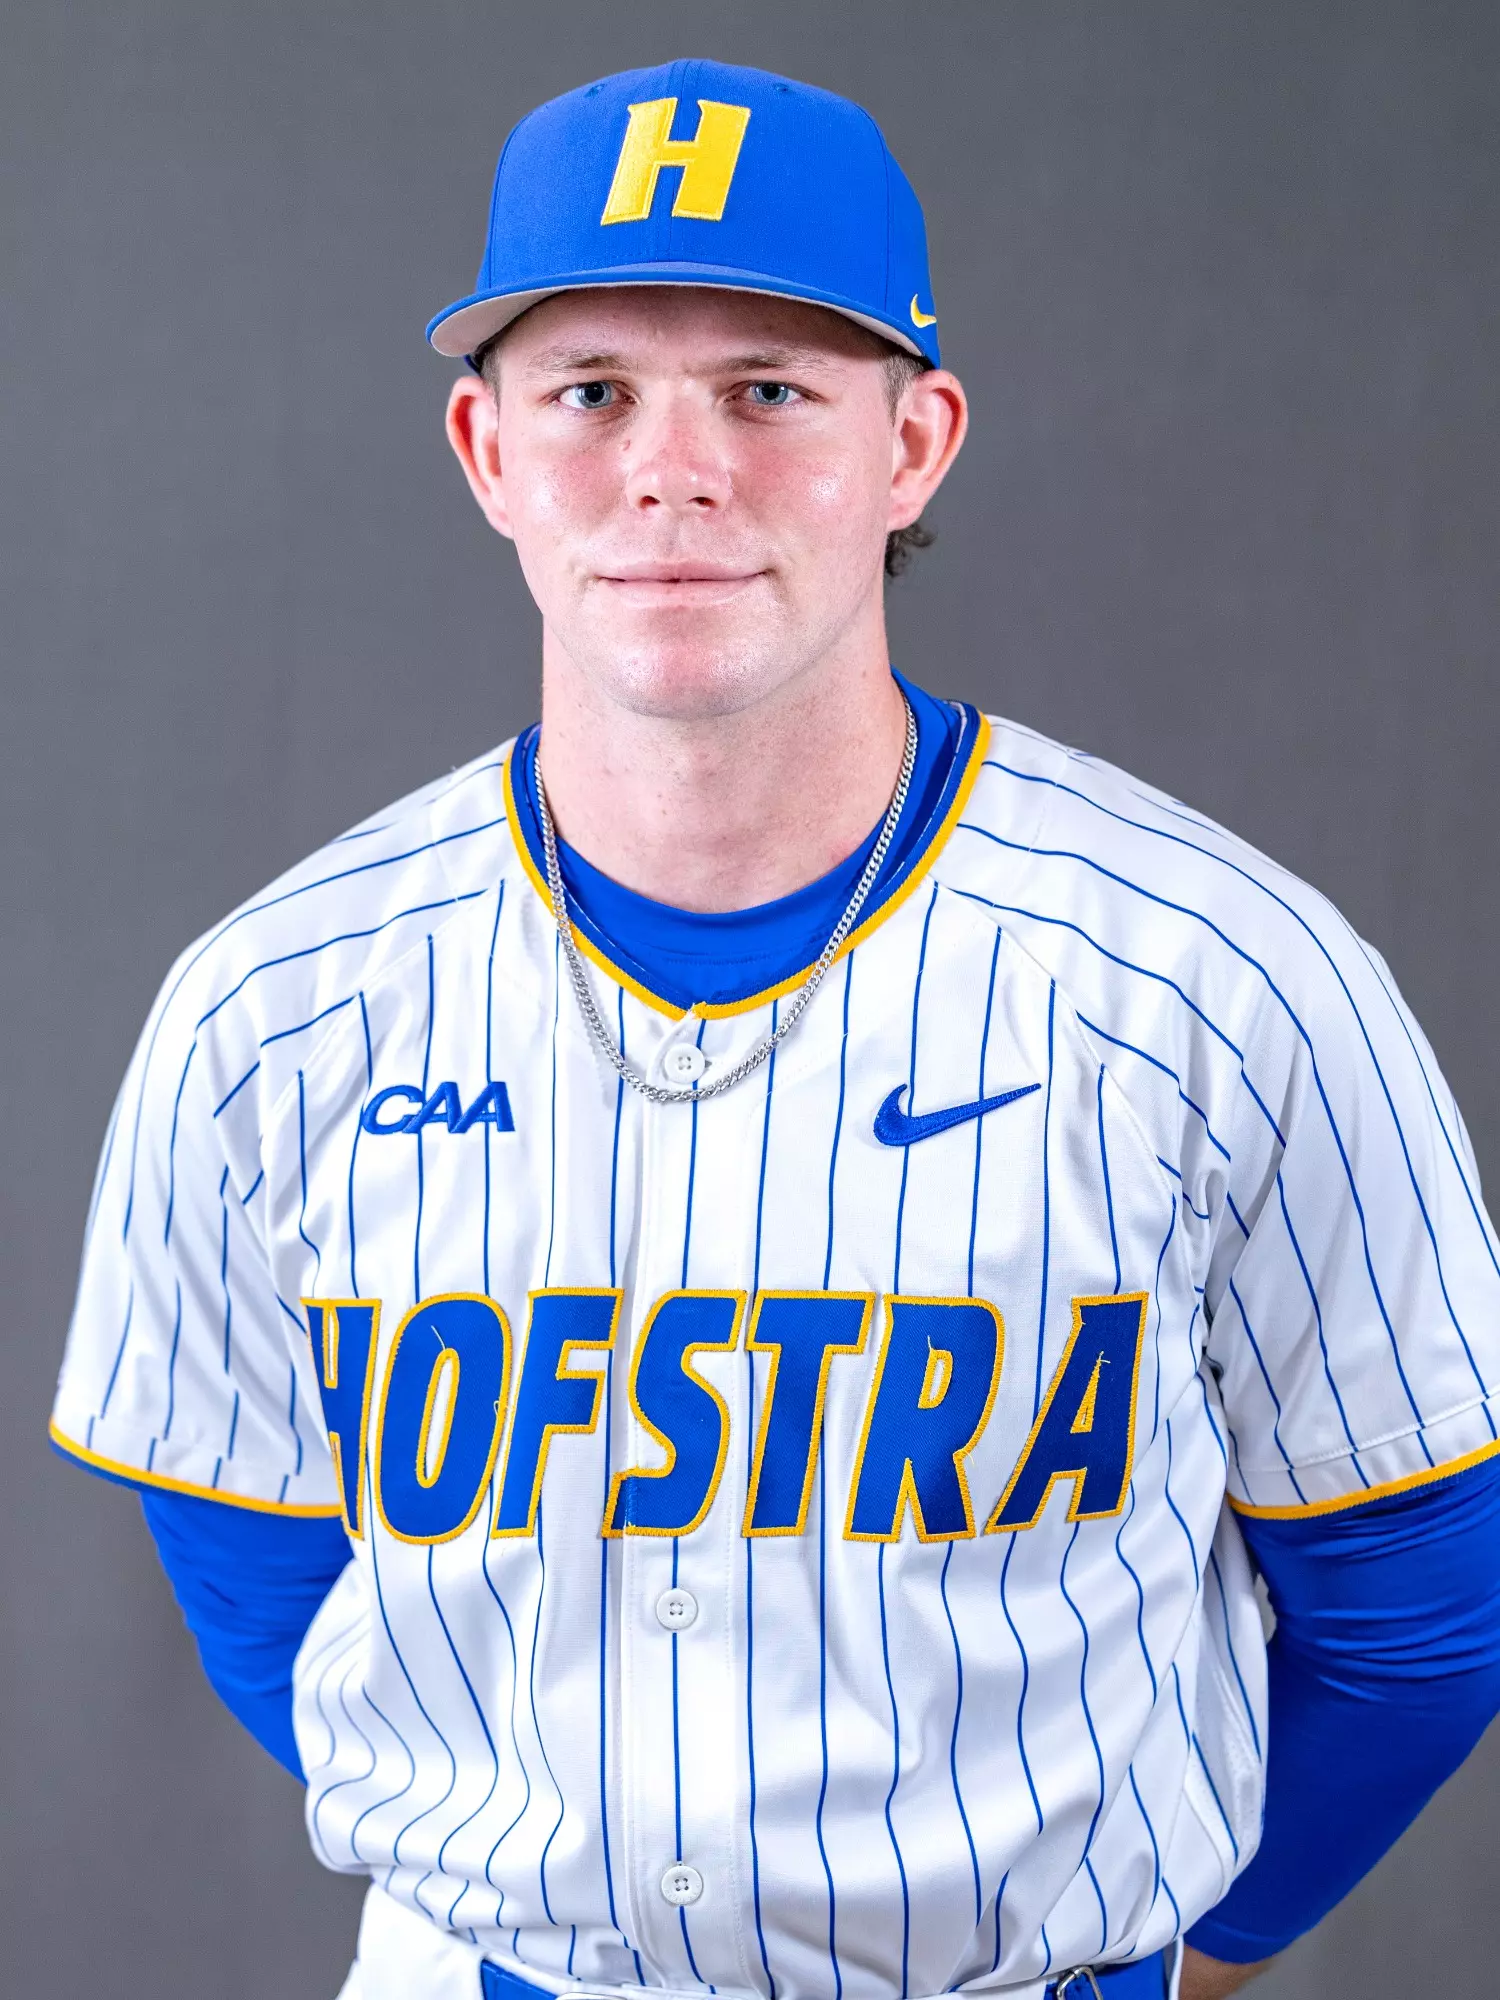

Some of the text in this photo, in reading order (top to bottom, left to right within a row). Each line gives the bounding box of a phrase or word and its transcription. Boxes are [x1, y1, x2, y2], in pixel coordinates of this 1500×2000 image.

[601, 97, 751, 226] H
[362, 1081, 516, 1135] CAA
[301, 1287, 1149, 1545] HOFSTRA
